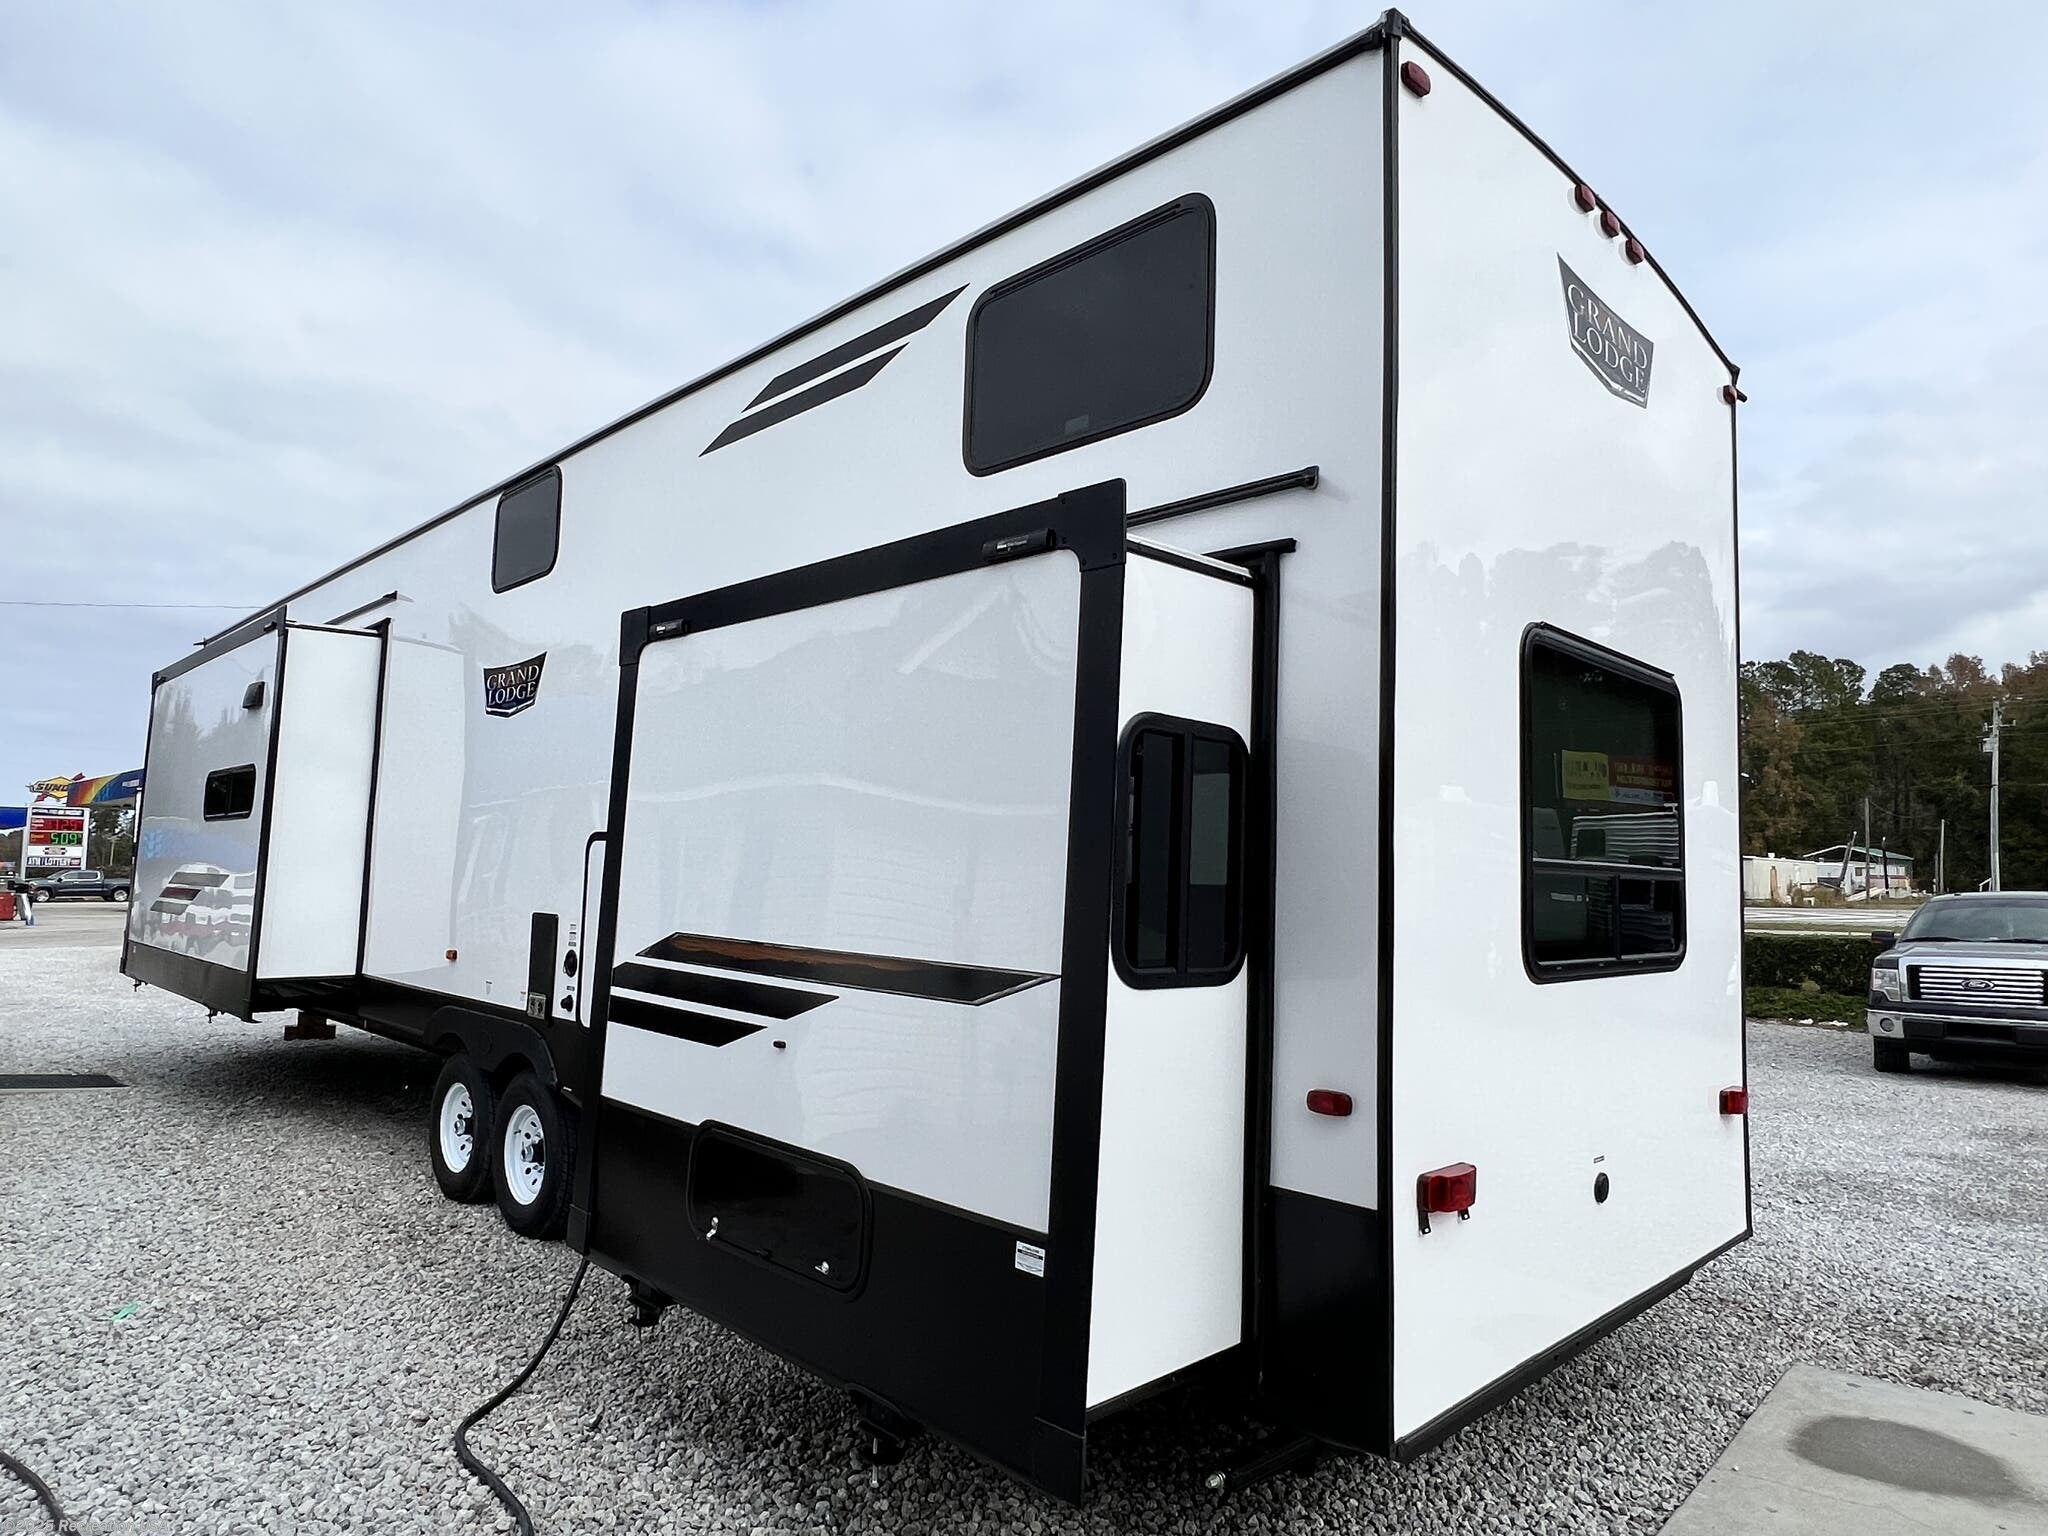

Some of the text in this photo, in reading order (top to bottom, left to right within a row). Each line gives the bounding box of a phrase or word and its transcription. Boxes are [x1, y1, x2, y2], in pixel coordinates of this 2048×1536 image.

[1567, 284, 1648, 369] GRAND
[1573, 311, 1646, 393] LODGE
[487, 665, 540, 690] GRAND
[488, 681, 536, 706] LODGE
